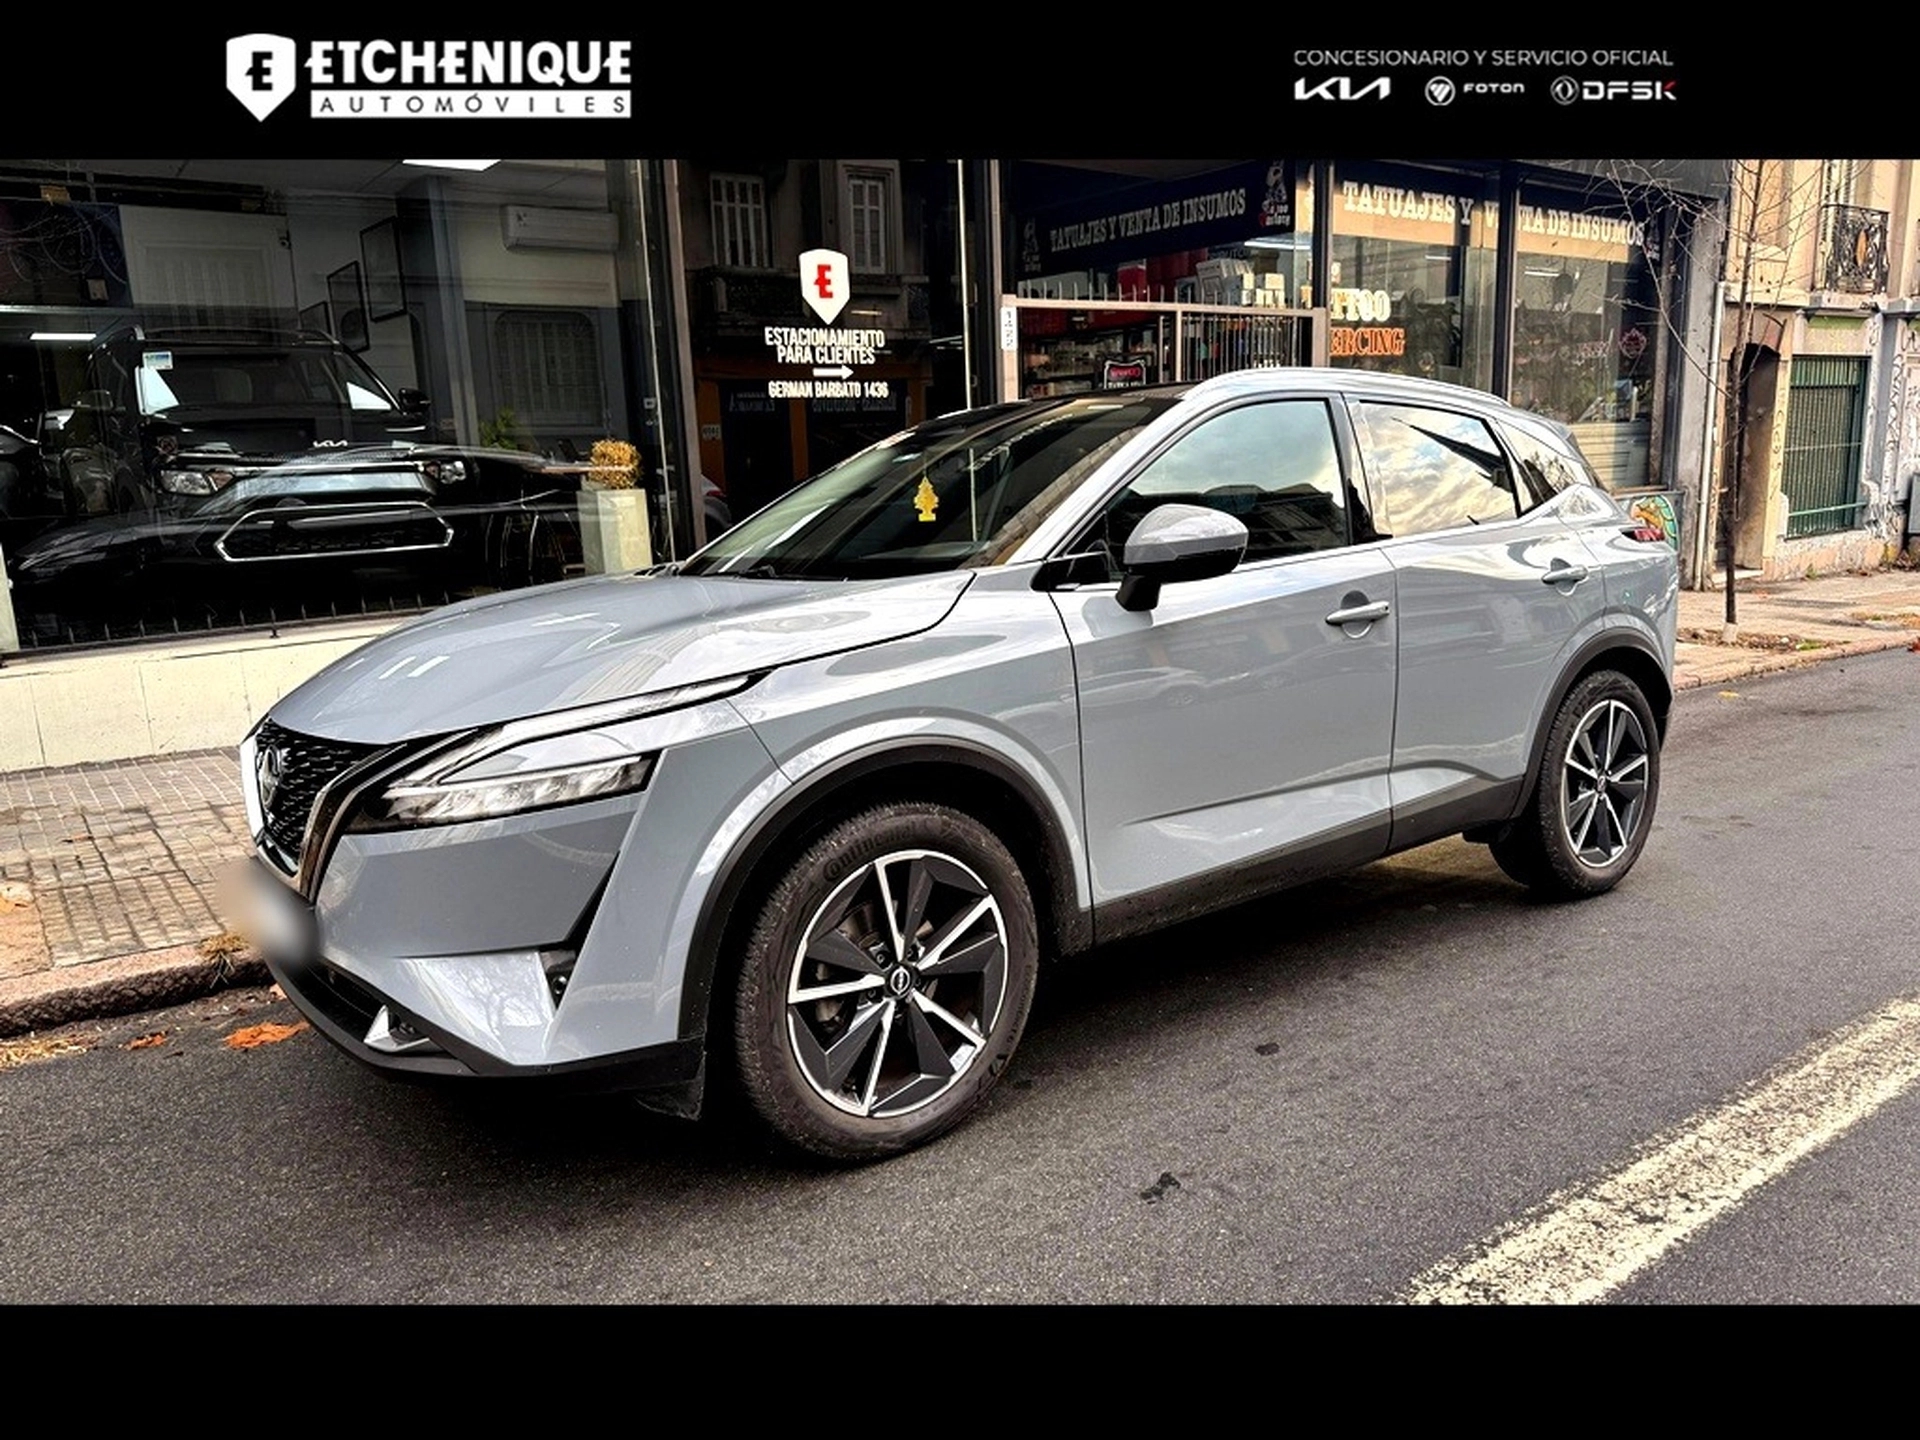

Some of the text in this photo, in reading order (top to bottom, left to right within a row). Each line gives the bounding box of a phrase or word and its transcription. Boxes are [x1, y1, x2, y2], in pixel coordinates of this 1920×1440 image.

[1050, 219, 1108, 252] TATUAJES
[1108, 215, 1118, 240] Y
[1119, 205, 1162, 236] VENTA
[1163, 201, 1181, 229] DE
[1183, 188, 1246, 224] INSUMOS
[1343, 180, 1456, 224] TATUAJES
[1459, 196, 1474, 225] Y
[1547, 209, 1571, 236] DE
[1571, 213, 1645, 246] INSUMOS
[764, 326, 886, 348] ESTACIONAMIENTO
[776, 346, 876, 364] PARA CLIENTES
[768, 381, 889, 398] GERMAN BARBATO 1436
